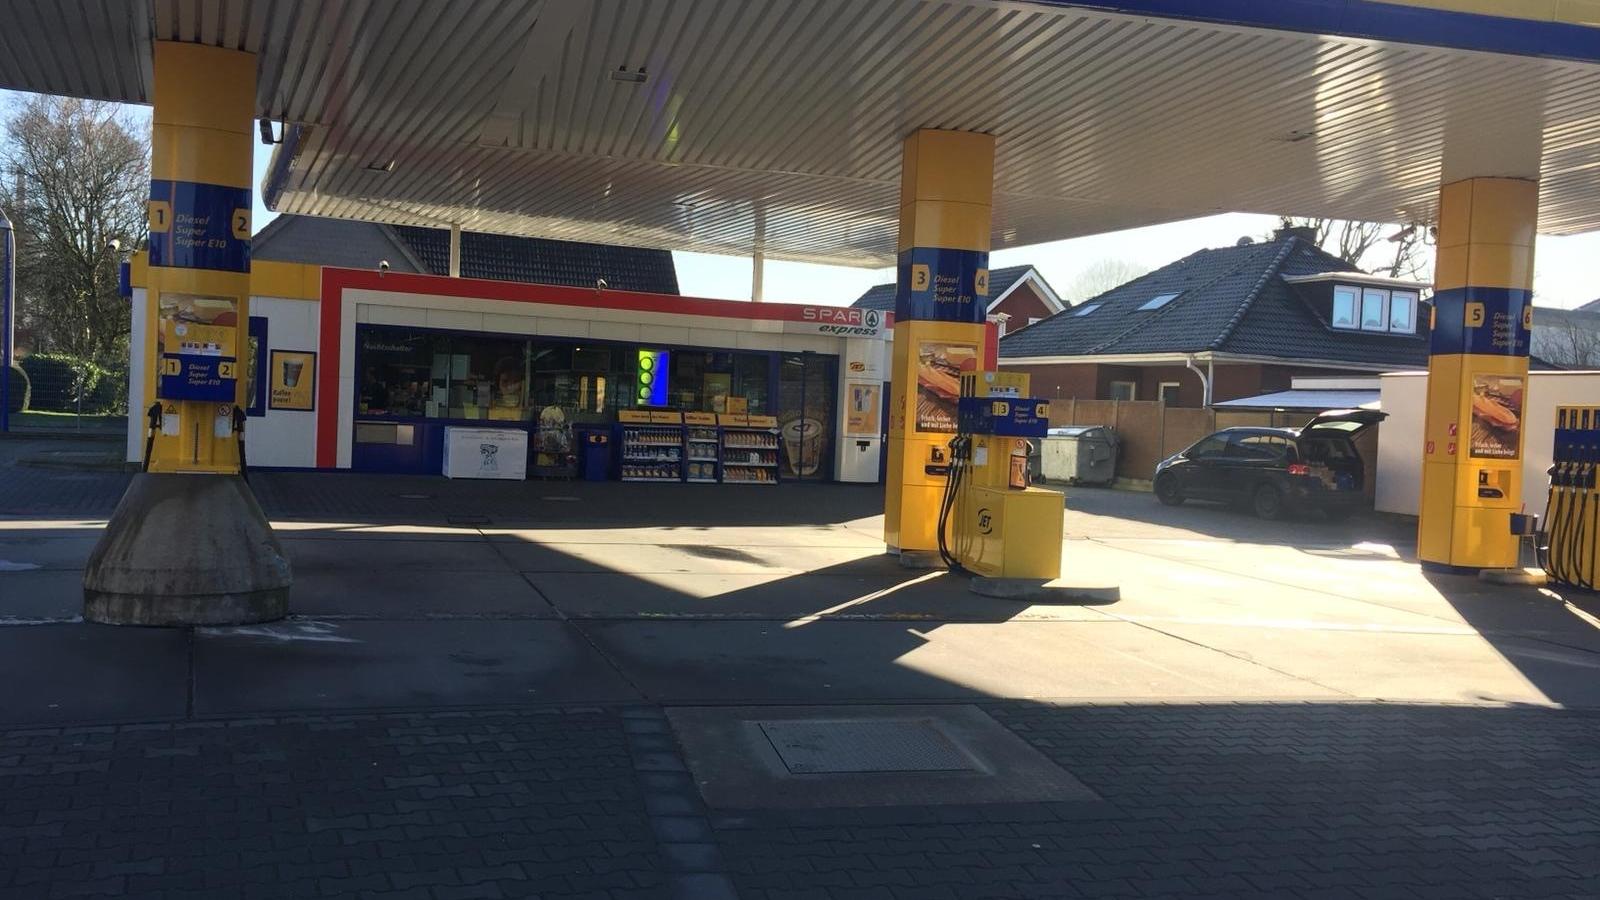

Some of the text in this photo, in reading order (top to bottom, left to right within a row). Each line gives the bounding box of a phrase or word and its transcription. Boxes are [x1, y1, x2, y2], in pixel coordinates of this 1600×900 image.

[156, 209, 164, 225] 1
[176, 214, 210, 225] Diesel
[238, 216, 247, 232] 2
[176, 225, 207, 236] Super
[175, 236, 227, 248] Super E10
[917, 271, 926, 285] 3
[934, 274, 960, 284] Diesel
[978, 275, 985, 288] 4
[933, 285, 957, 294] Super
[932, 294, 971, 304] Super E10
[803, 307, 860, 322] SPAR
[1472, 308, 1480, 321] 5
[1525, 312, 1530, 324] 6
[819, 325, 878, 336] express
[170, 362, 176, 373] 1
[188, 363, 210, 371] Diesel
[222, 364, 230, 375] 2
[188, 371, 208, 379] Super
[188, 378, 207, 386] Super
[1000, 404, 1007, 414] 3
[1037, 406, 1044, 415] 4
[979, 515, 991, 528] JET
